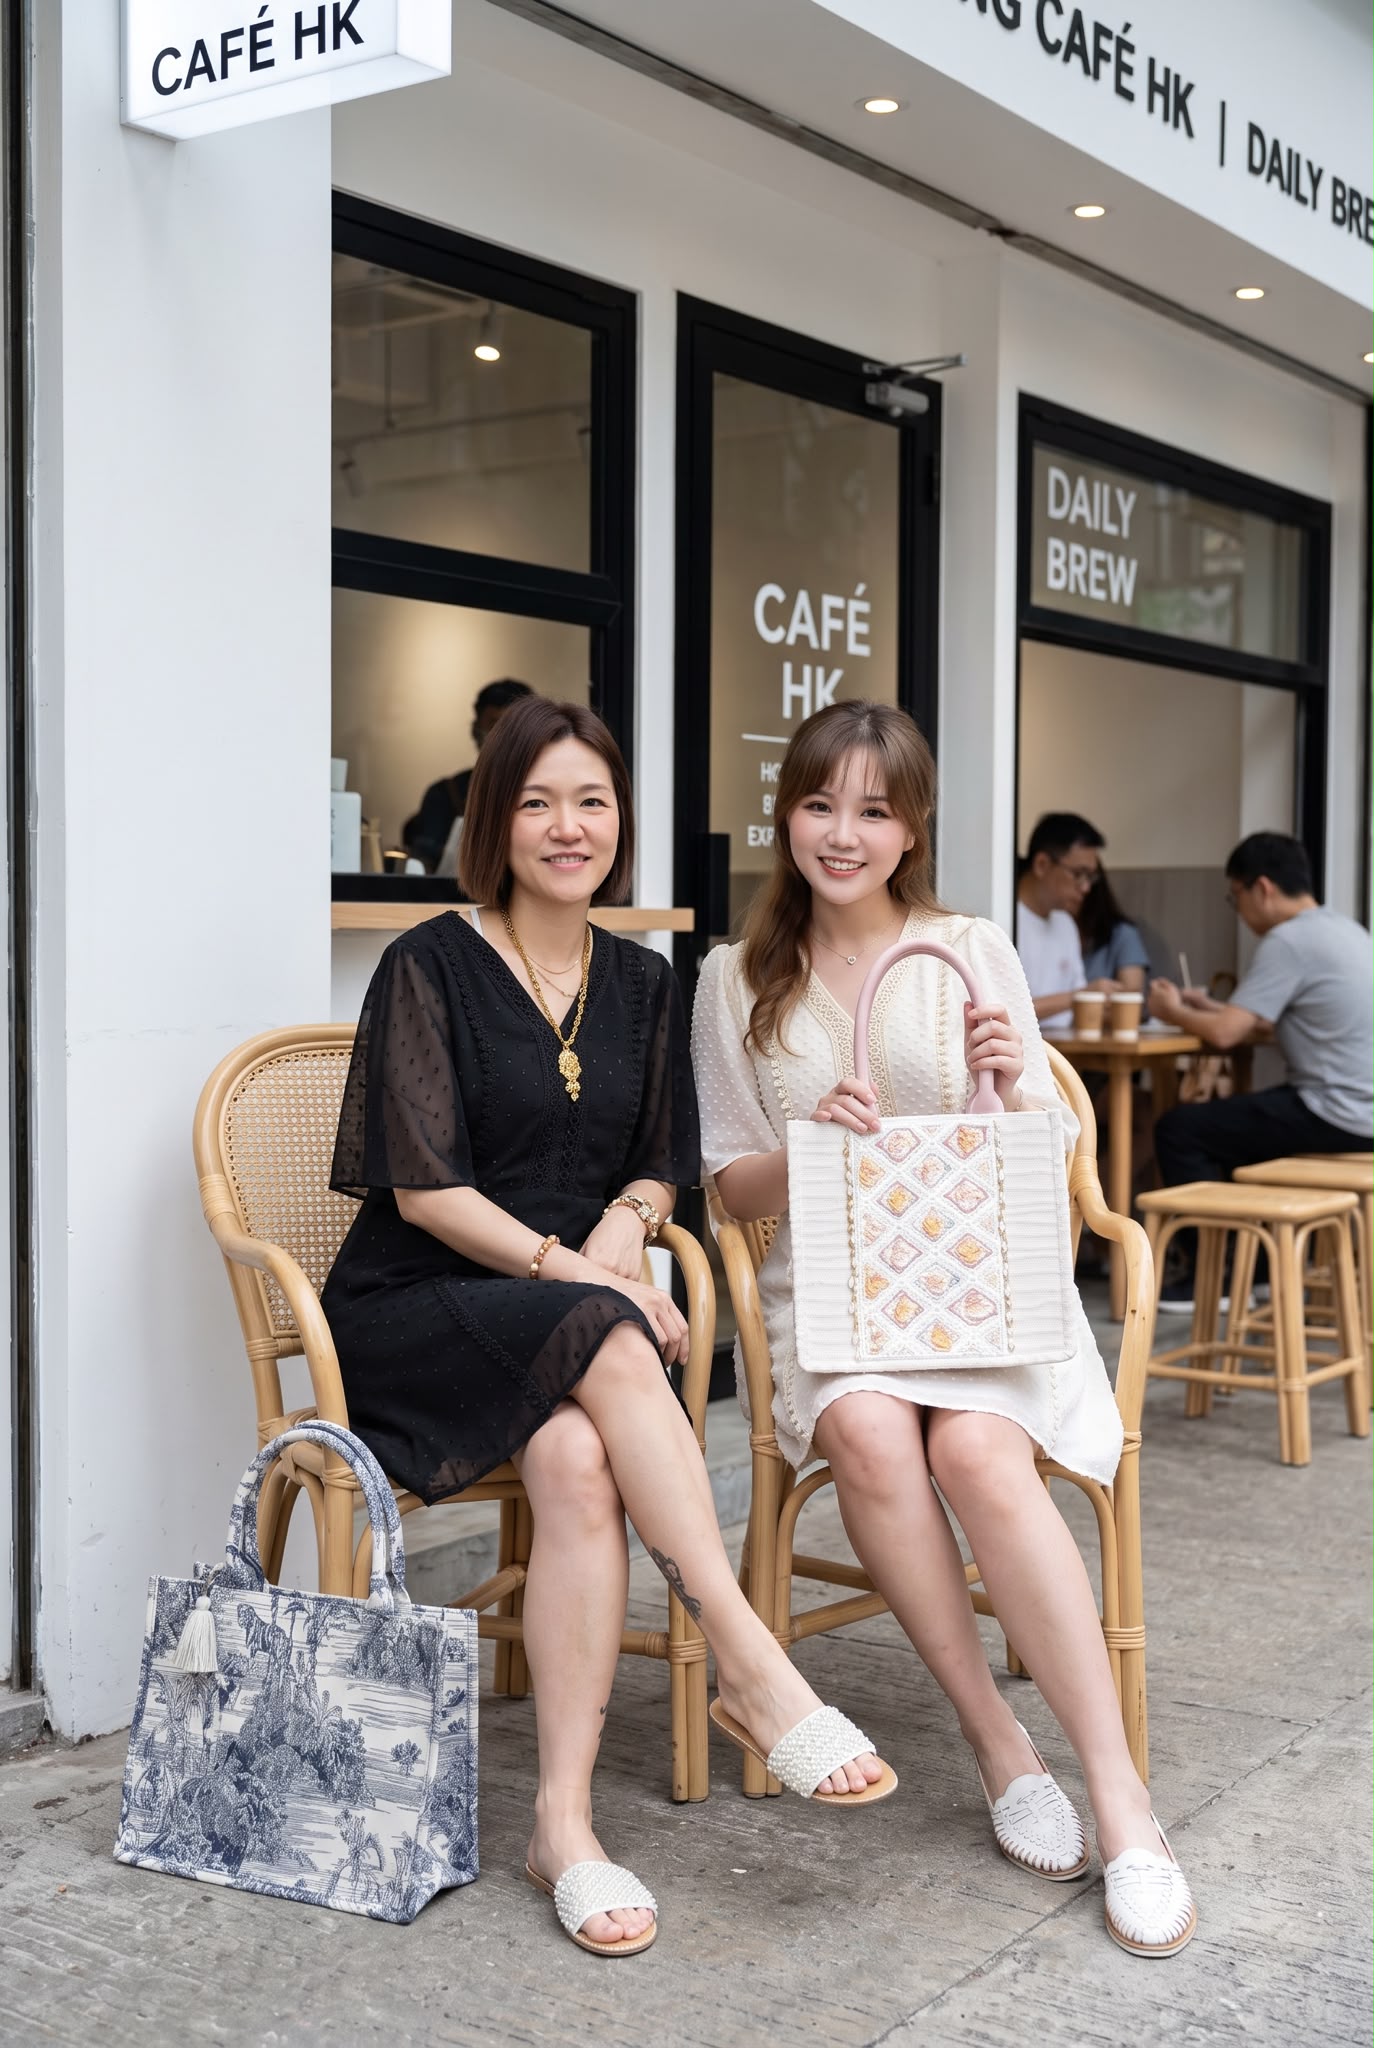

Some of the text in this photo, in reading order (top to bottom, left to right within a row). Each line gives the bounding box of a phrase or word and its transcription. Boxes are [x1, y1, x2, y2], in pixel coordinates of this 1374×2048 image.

[152, 0, 364, 95] CAFÉ HK
[1036, 0, 1135, 101] CAFÉ
[1147, 57, 1195, 138] HK
[1248, 121, 1323, 211] DAILY
[1048, 466, 1136, 540] DAILY
[1047, 537, 1138, 607] BREW
[754, 582, 871, 657] CAFÉ
[782, 661, 844, 719] HK
